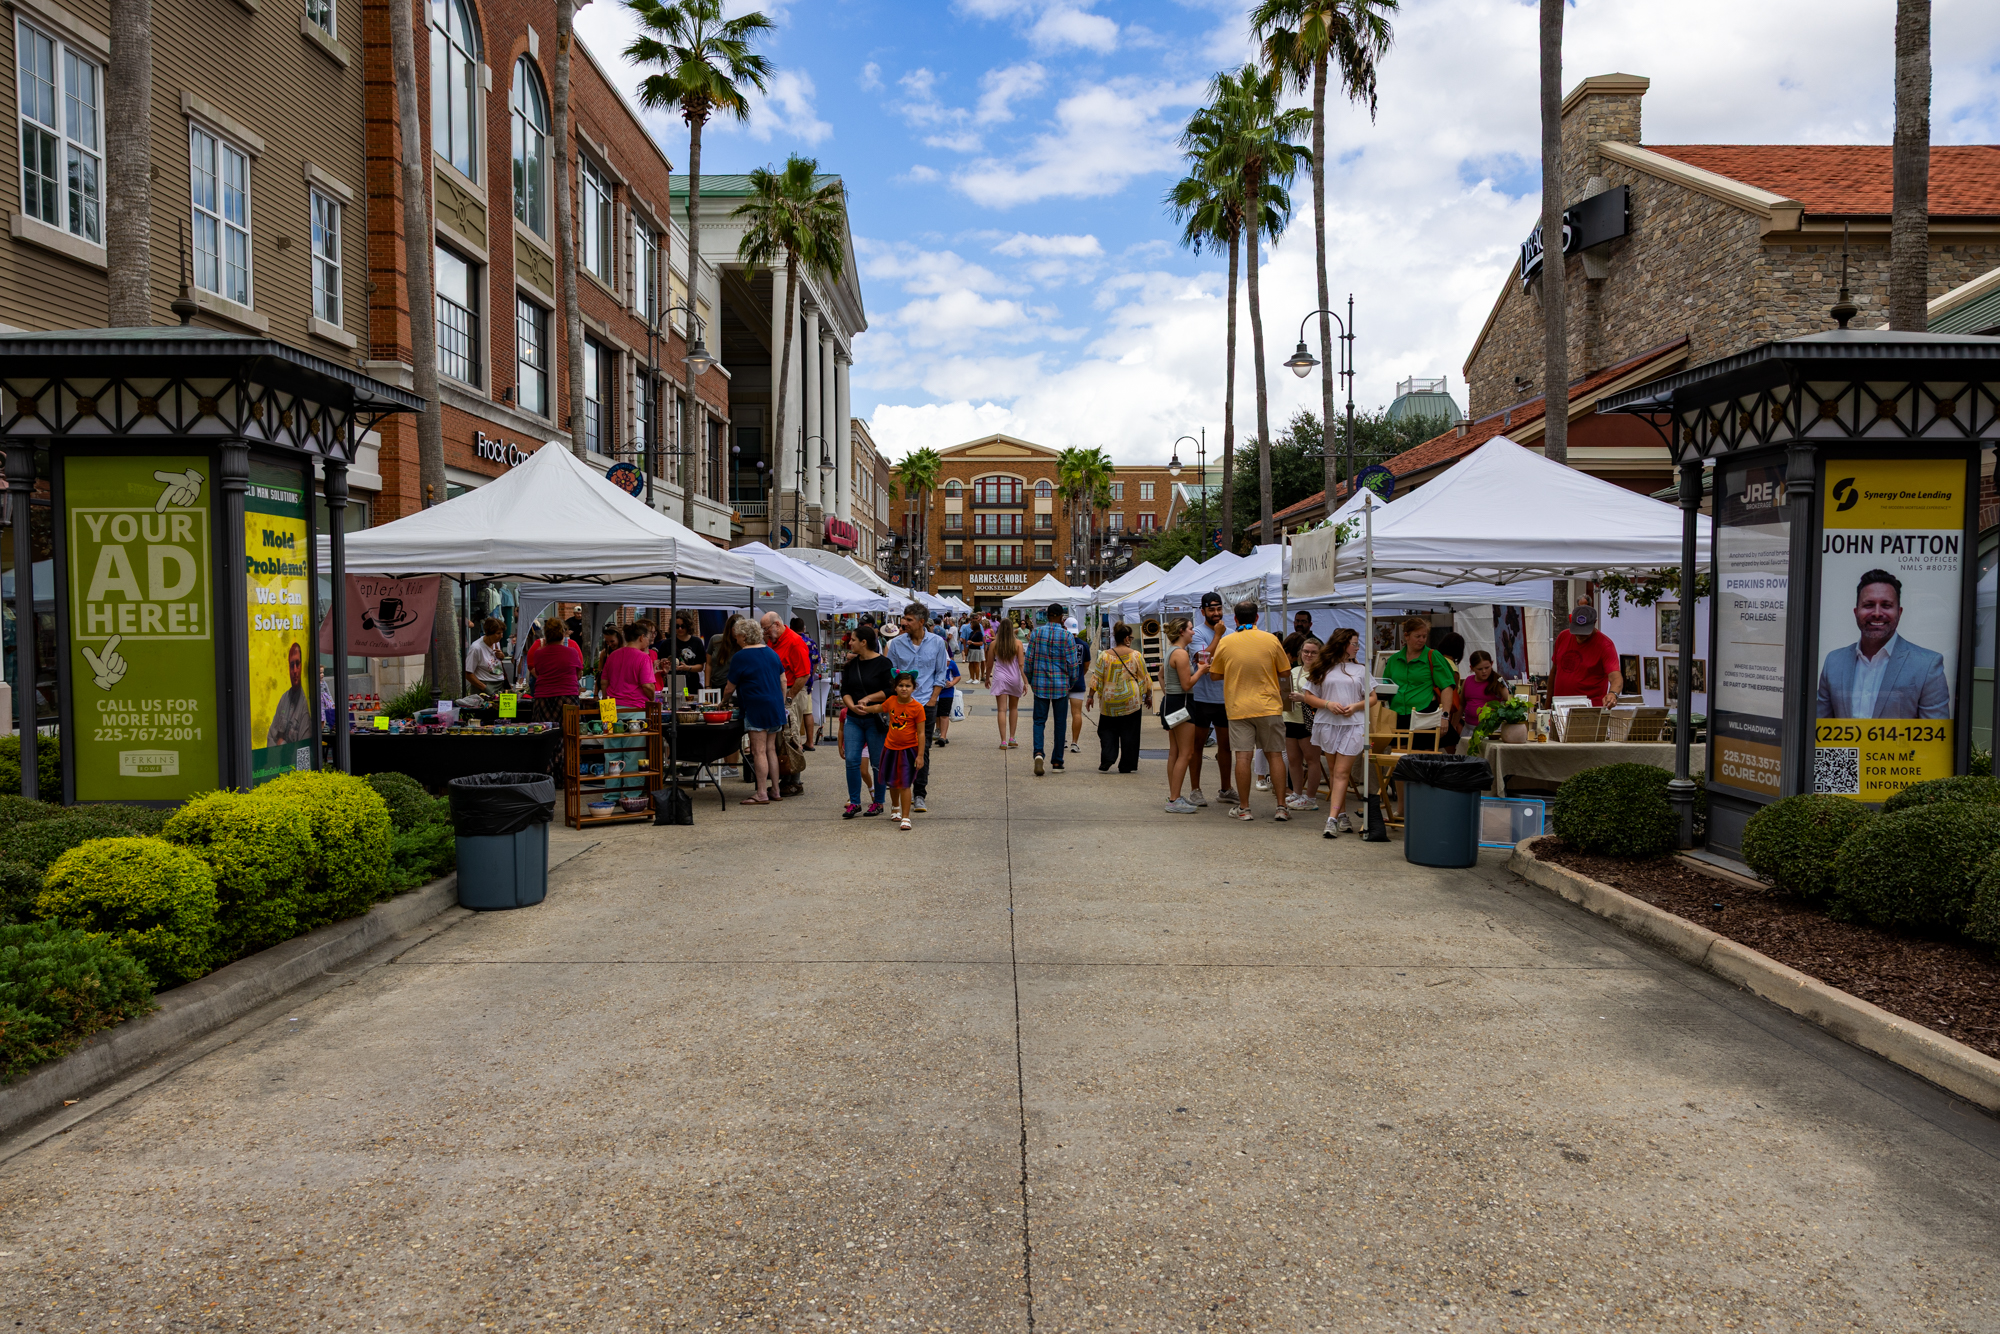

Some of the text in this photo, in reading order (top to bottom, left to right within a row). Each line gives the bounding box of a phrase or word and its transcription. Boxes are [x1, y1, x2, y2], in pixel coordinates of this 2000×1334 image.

[477, 431, 506, 464] Frock
[256, 486, 269, 499] MAN
[270, 489, 298, 504] SOLUTIONS
[1740, 482, 1773, 504] JRE
[1864, 491, 1952, 500] Synergy One Lending
[1746, 502, 1772, 510] BROKERAGE
[83, 514, 196, 543] YOUR
[262, 529, 295, 549] Mold
[1822, 534, 1959, 554] JOHN PATTON
[86, 544, 197, 601] AD
[246, 555, 307, 577] Problems?
[1727, 578, 1788, 589] PERKINS ROW
[255, 587, 302, 605] We Can
[1734, 600, 1784, 609] RETAIL SPACE
[86, 603, 199, 633] HERE!
[254, 613, 304, 631] Solve It!
[1740, 612, 1777, 621] FOR LEASE
[1757, 684, 1784, 693] EXPERIENC
[96, 699, 199, 712] CALL US FOR
[102, 713, 194, 726] MORE INFO
[93, 727, 202, 741] 225-767-2001
[1728, 721, 1776, 736] WILL CHADWICK
[1815, 725, 1946, 743] (225) 614-1234
[124, 756, 175, 764] PERKINS
[1723, 749, 1781, 772] 225.753.3573
[1866, 752, 1915, 761] SCAN ME
[1866, 767, 1921, 776] FOR MORE
